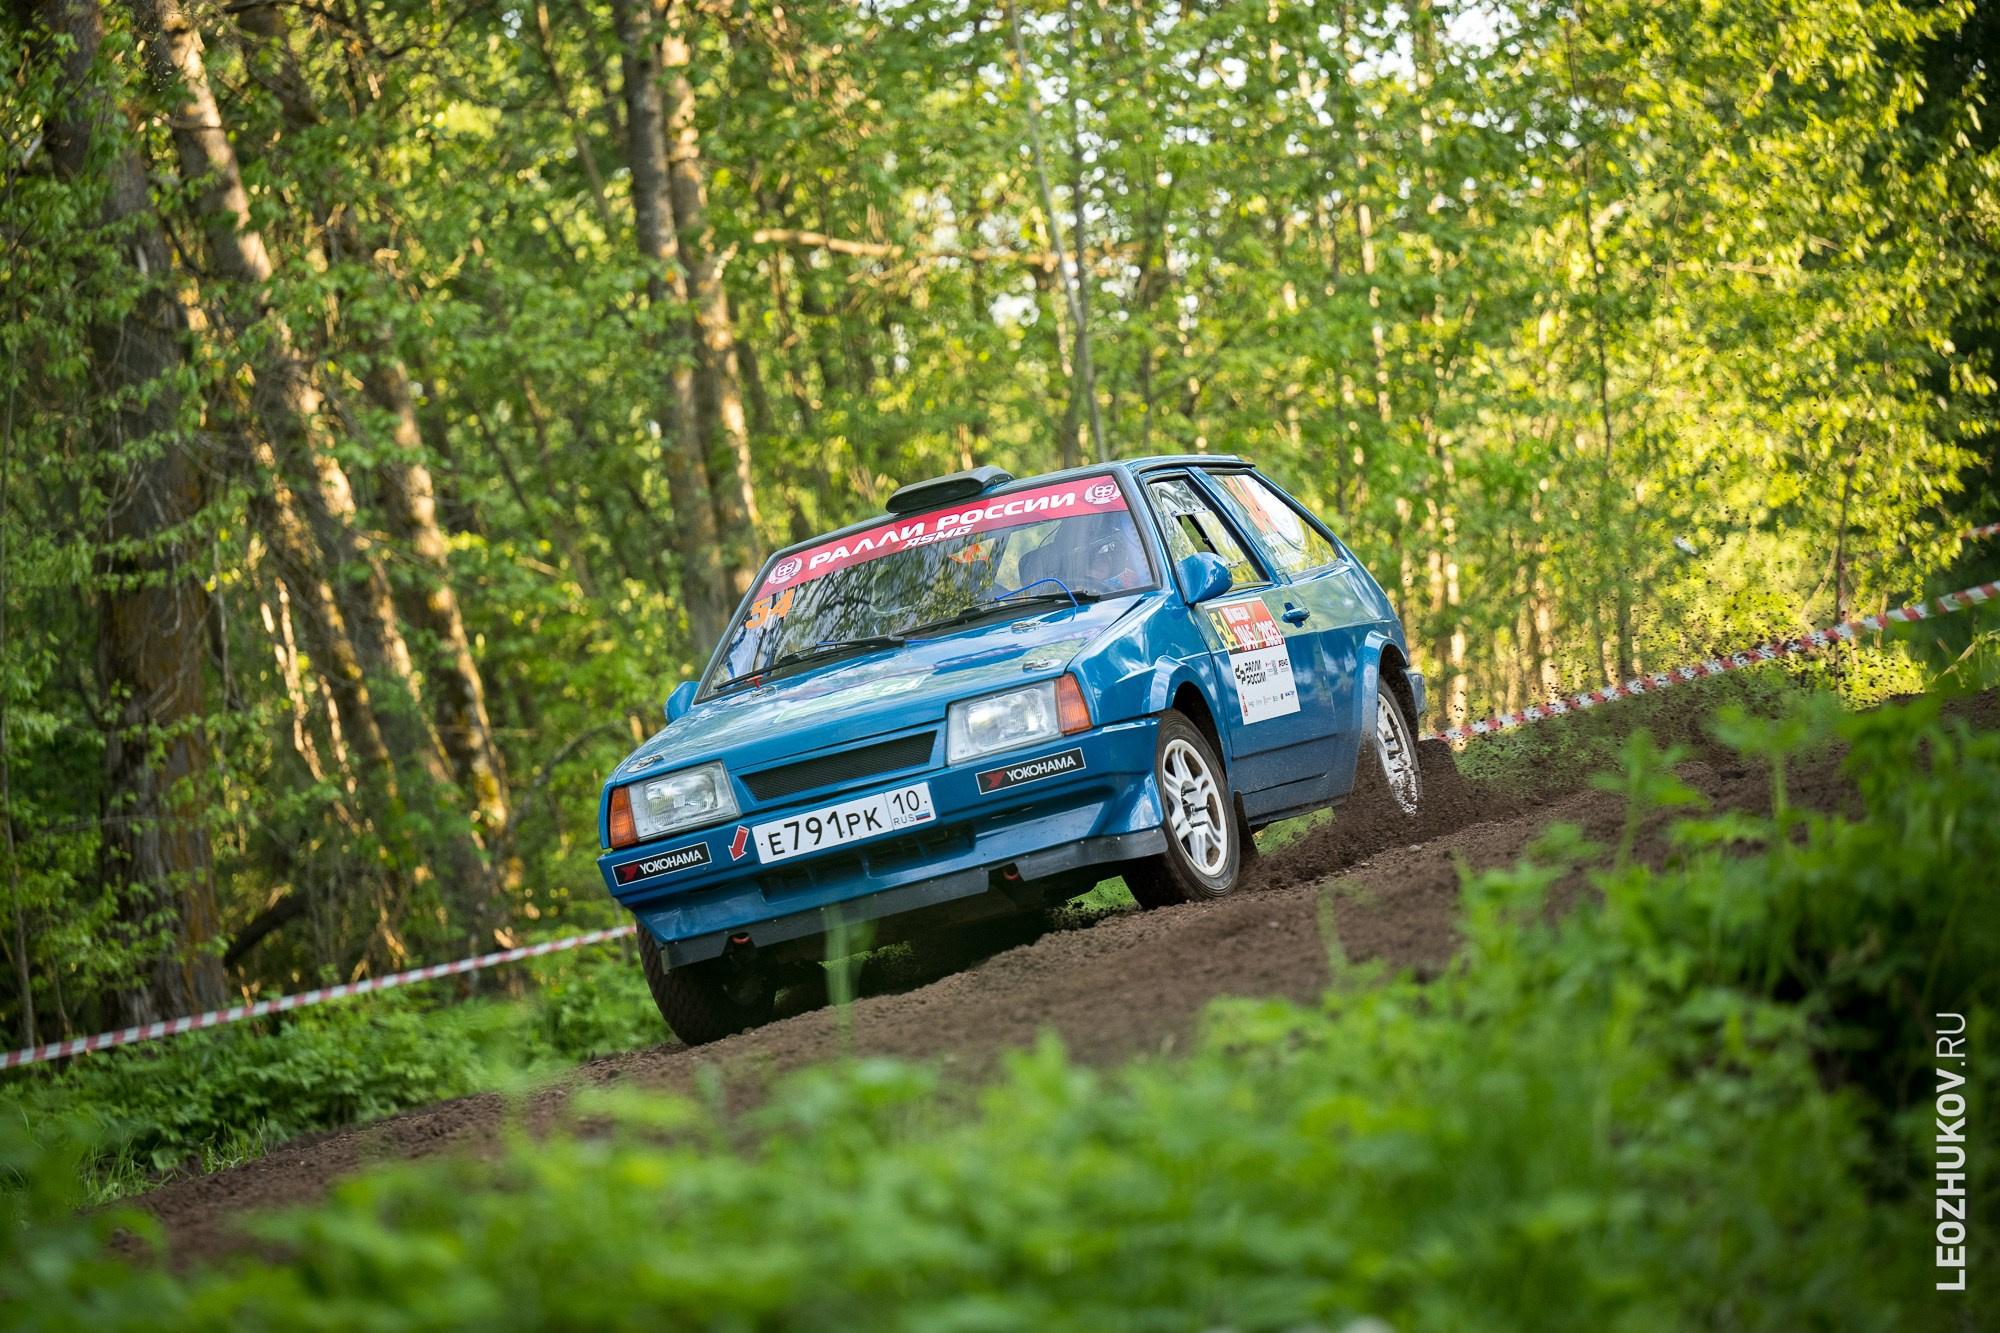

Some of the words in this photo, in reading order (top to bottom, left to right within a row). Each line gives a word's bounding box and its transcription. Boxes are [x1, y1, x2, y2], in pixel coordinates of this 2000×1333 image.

[808, 522, 924, 570] РАЛЛИ
[937, 491, 1076, 531] РОССИИ
[745, 589, 796, 630] 54
[1209, 611, 1241, 651] 54
[1005, 754, 1077, 785] YOKOHAMA
[769, 806, 883, 856] Е791РК
[892, 788, 922, 814] 10
[894, 813, 916, 827] RUS
[638, 849, 704, 876] YOKOHAMA
